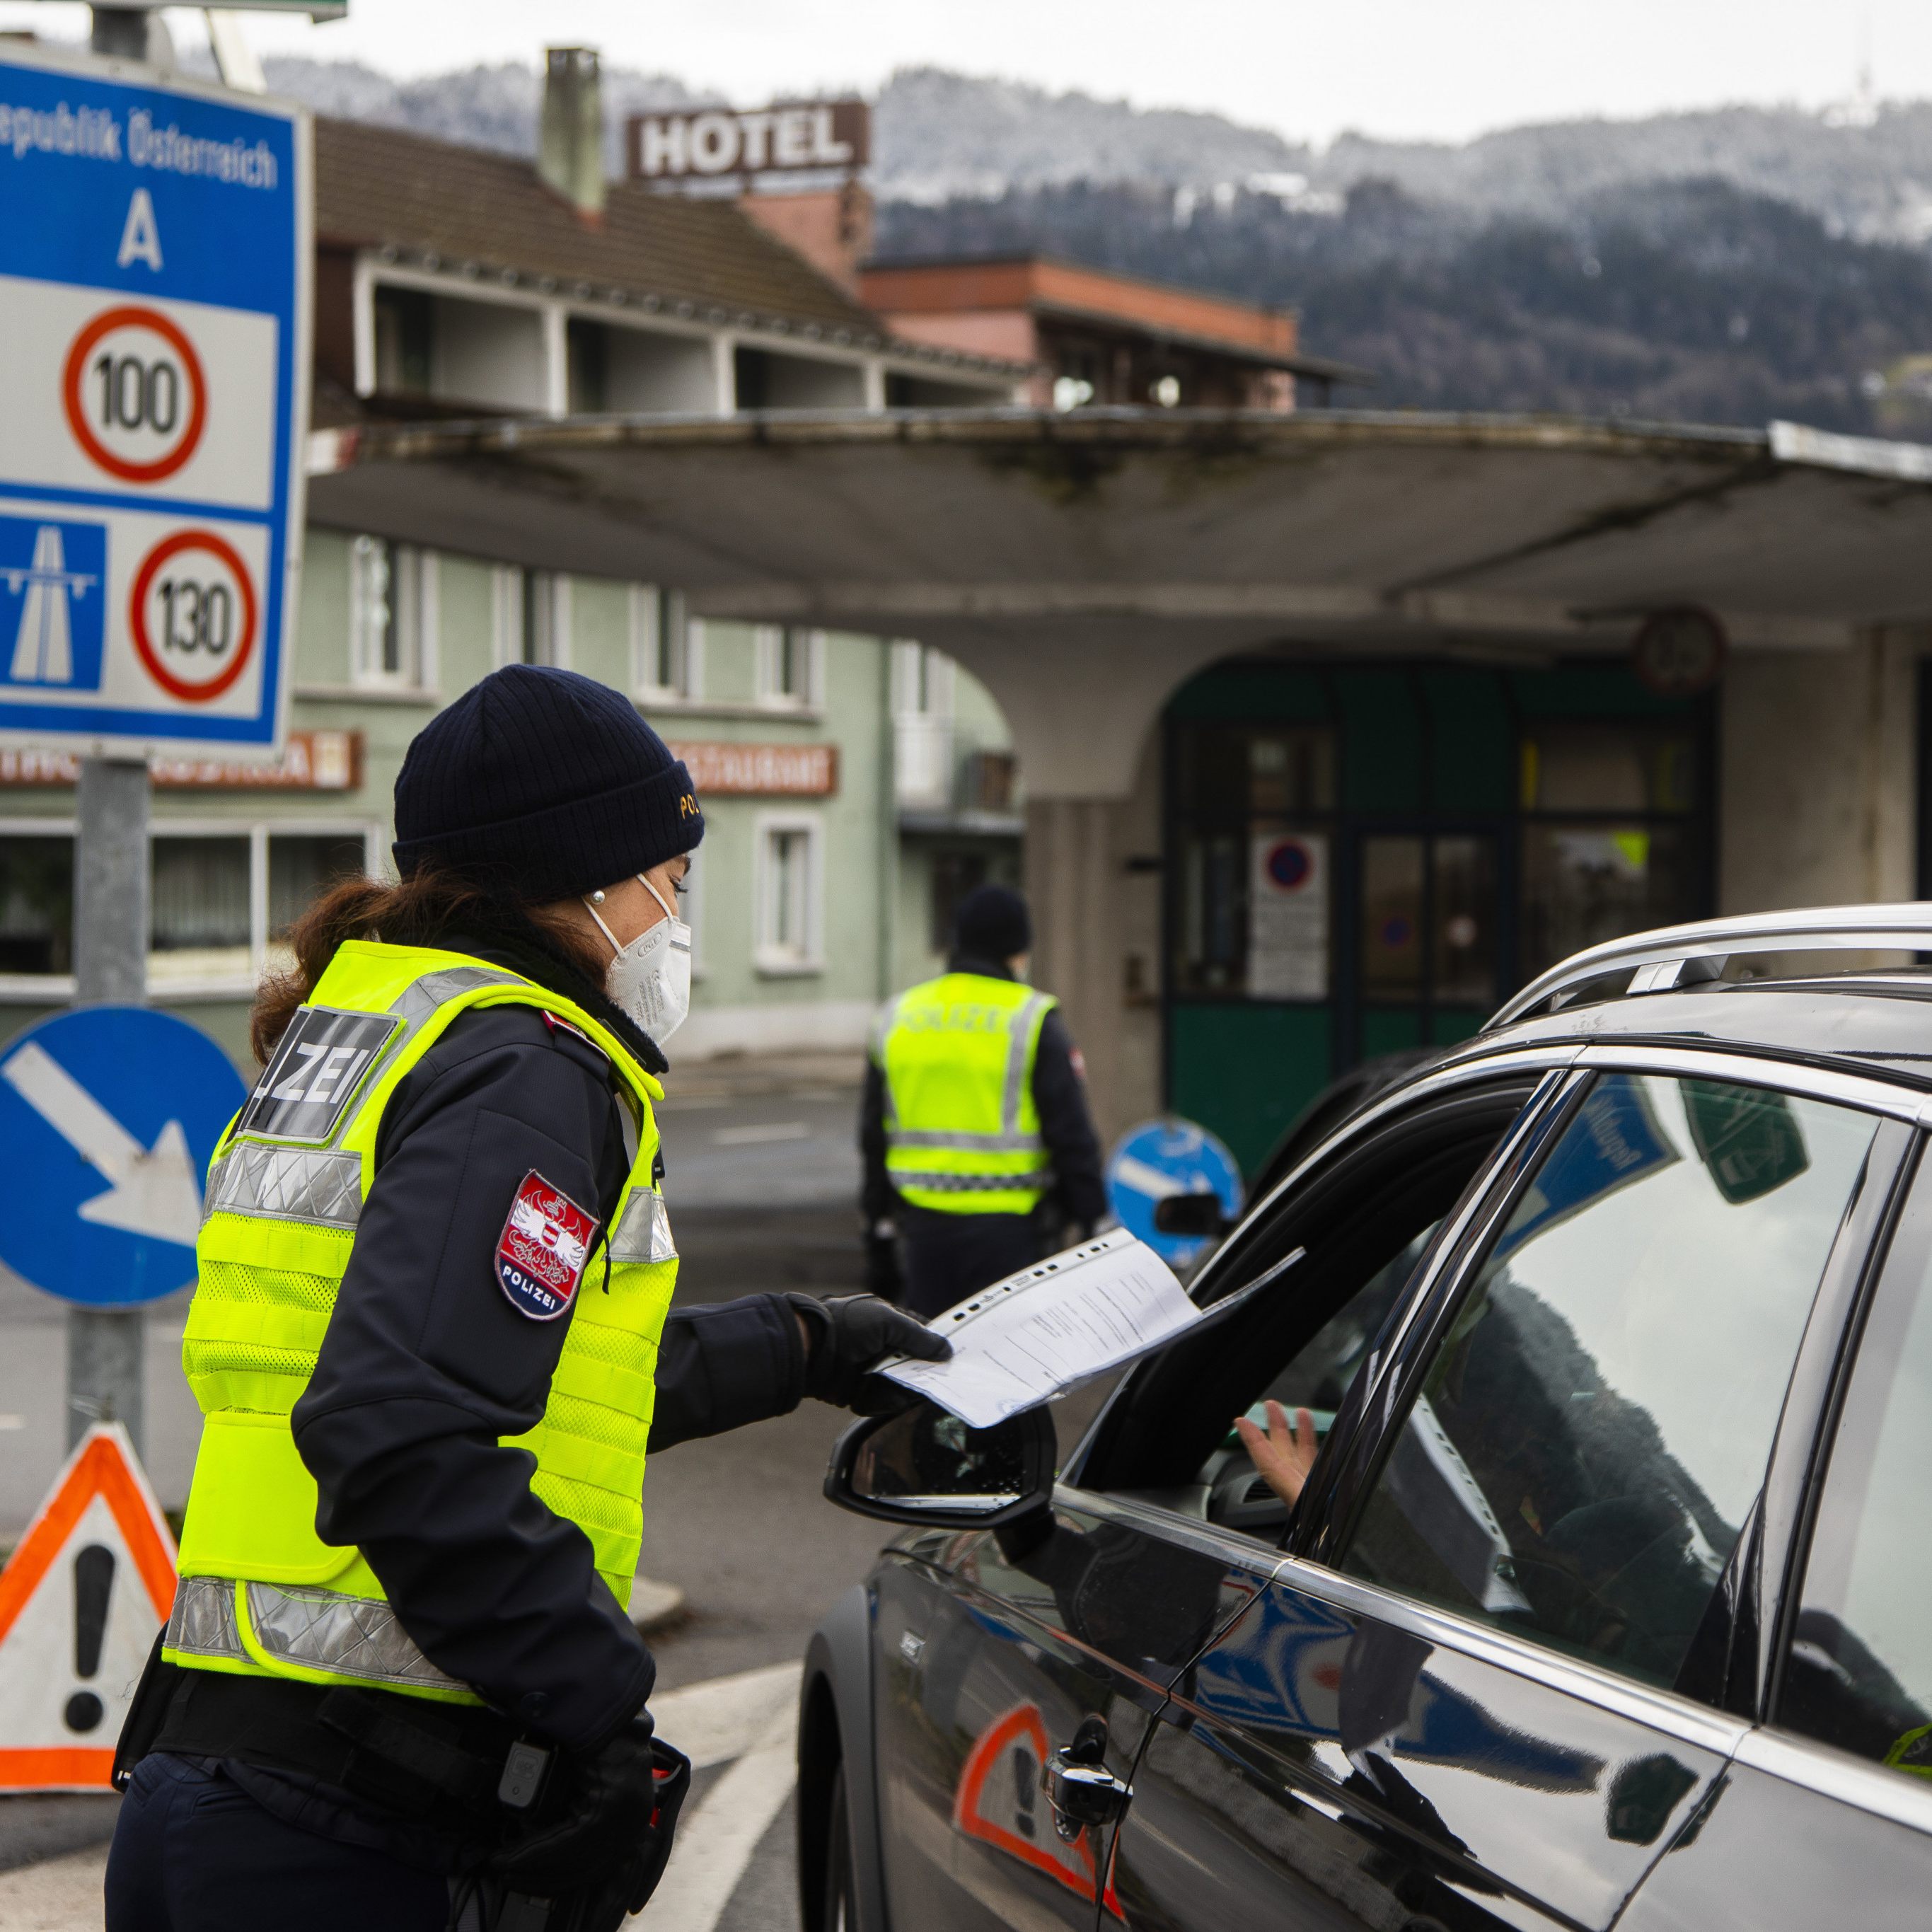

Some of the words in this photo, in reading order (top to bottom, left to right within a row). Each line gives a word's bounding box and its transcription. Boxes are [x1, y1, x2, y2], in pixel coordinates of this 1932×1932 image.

[128, 107, 279, 190] Österreich
[641, 108, 854, 174] HOTEL
[117, 187, 164, 272] A
[95, 352, 178, 434] 100
[157, 577, 231, 654] 130
[502, 1265, 555, 1309] POLIZEI
